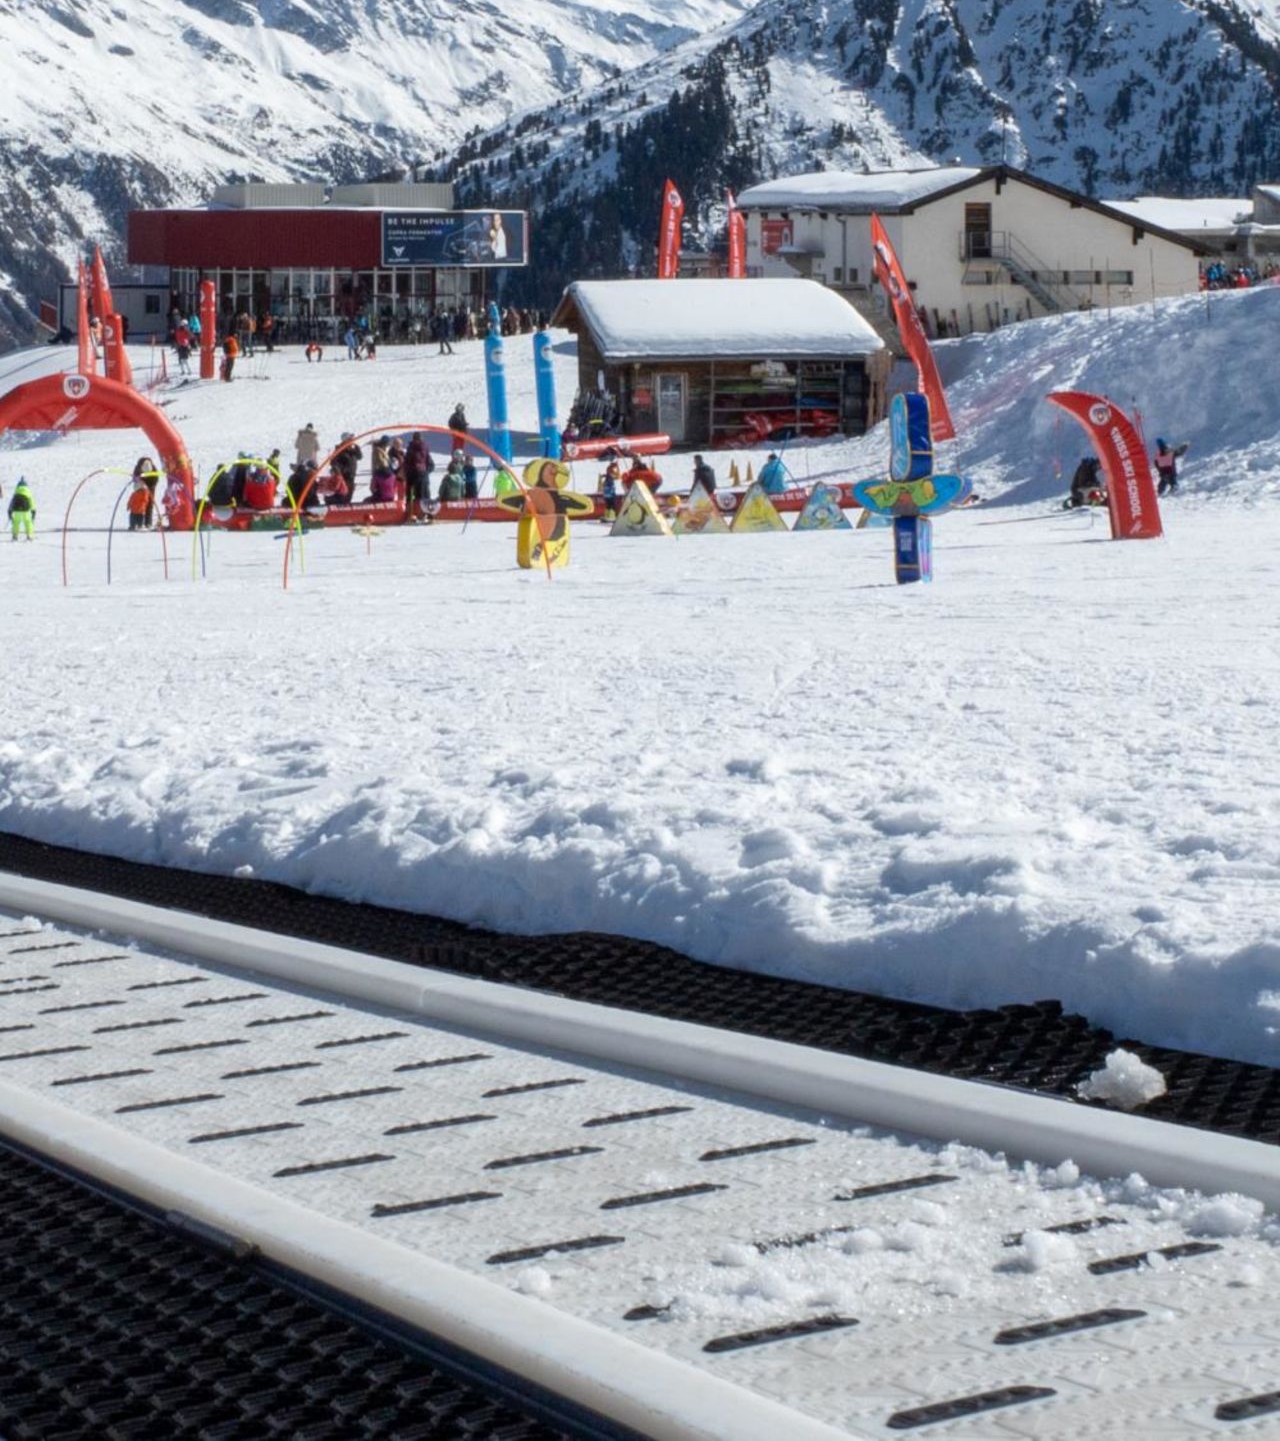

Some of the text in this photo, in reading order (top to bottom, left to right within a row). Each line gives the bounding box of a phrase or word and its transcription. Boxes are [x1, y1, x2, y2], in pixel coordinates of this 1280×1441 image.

[1111, 426, 1142, 520] SWISS SKI SCHOOL
